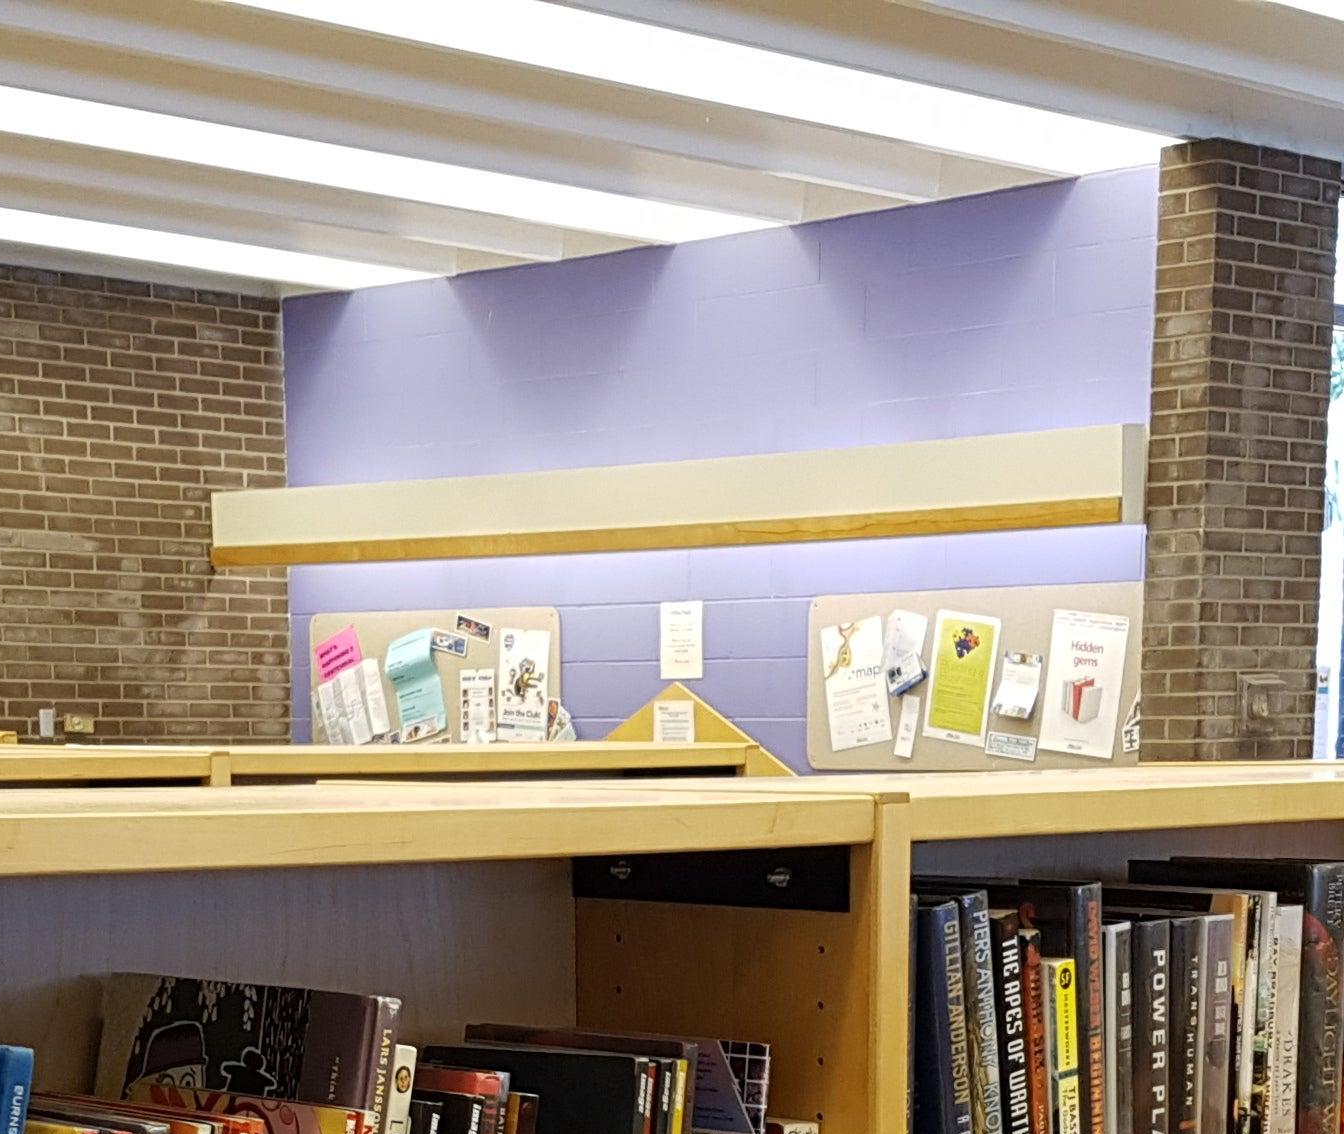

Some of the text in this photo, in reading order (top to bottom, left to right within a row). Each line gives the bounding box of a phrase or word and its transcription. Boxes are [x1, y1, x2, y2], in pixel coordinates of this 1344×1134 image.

[1071, 640, 1104, 654] Hidden
[1073, 656, 1098, 668] gems
[972, 910, 990, 963] PIERS
[1001, 935, 1020, 977] THE
[974, 968, 997, 1070] ANTHONY
[1004, 980, 1021, 1034] APES
[1151, 950, 1167, 1069] POWER
[1006, 1039, 1023, 1063] OF
